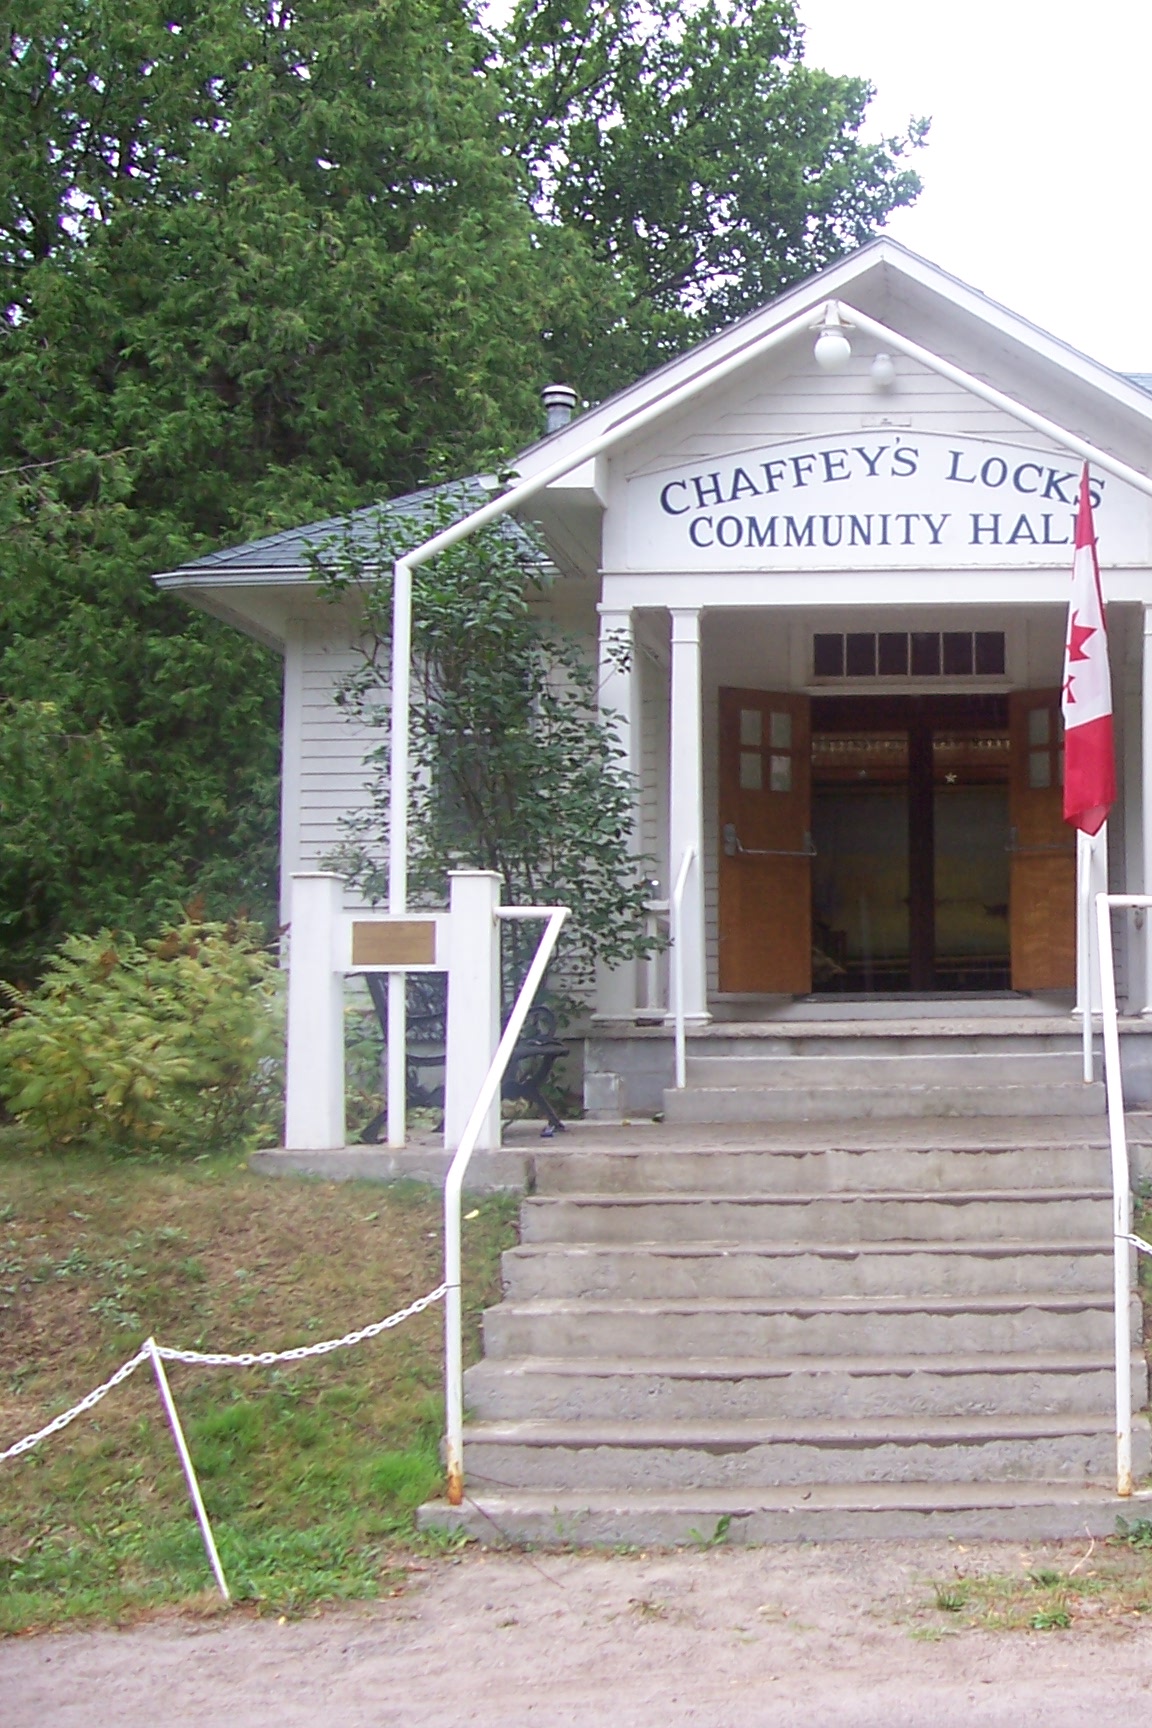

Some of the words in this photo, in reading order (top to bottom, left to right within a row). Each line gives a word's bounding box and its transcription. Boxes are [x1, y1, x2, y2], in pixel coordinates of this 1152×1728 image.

[660, 437, 920, 515] CHAFFEY'S
[945, 450, 1106, 510] LOCKS
[689, 513, 951, 548] COMMUNITY
